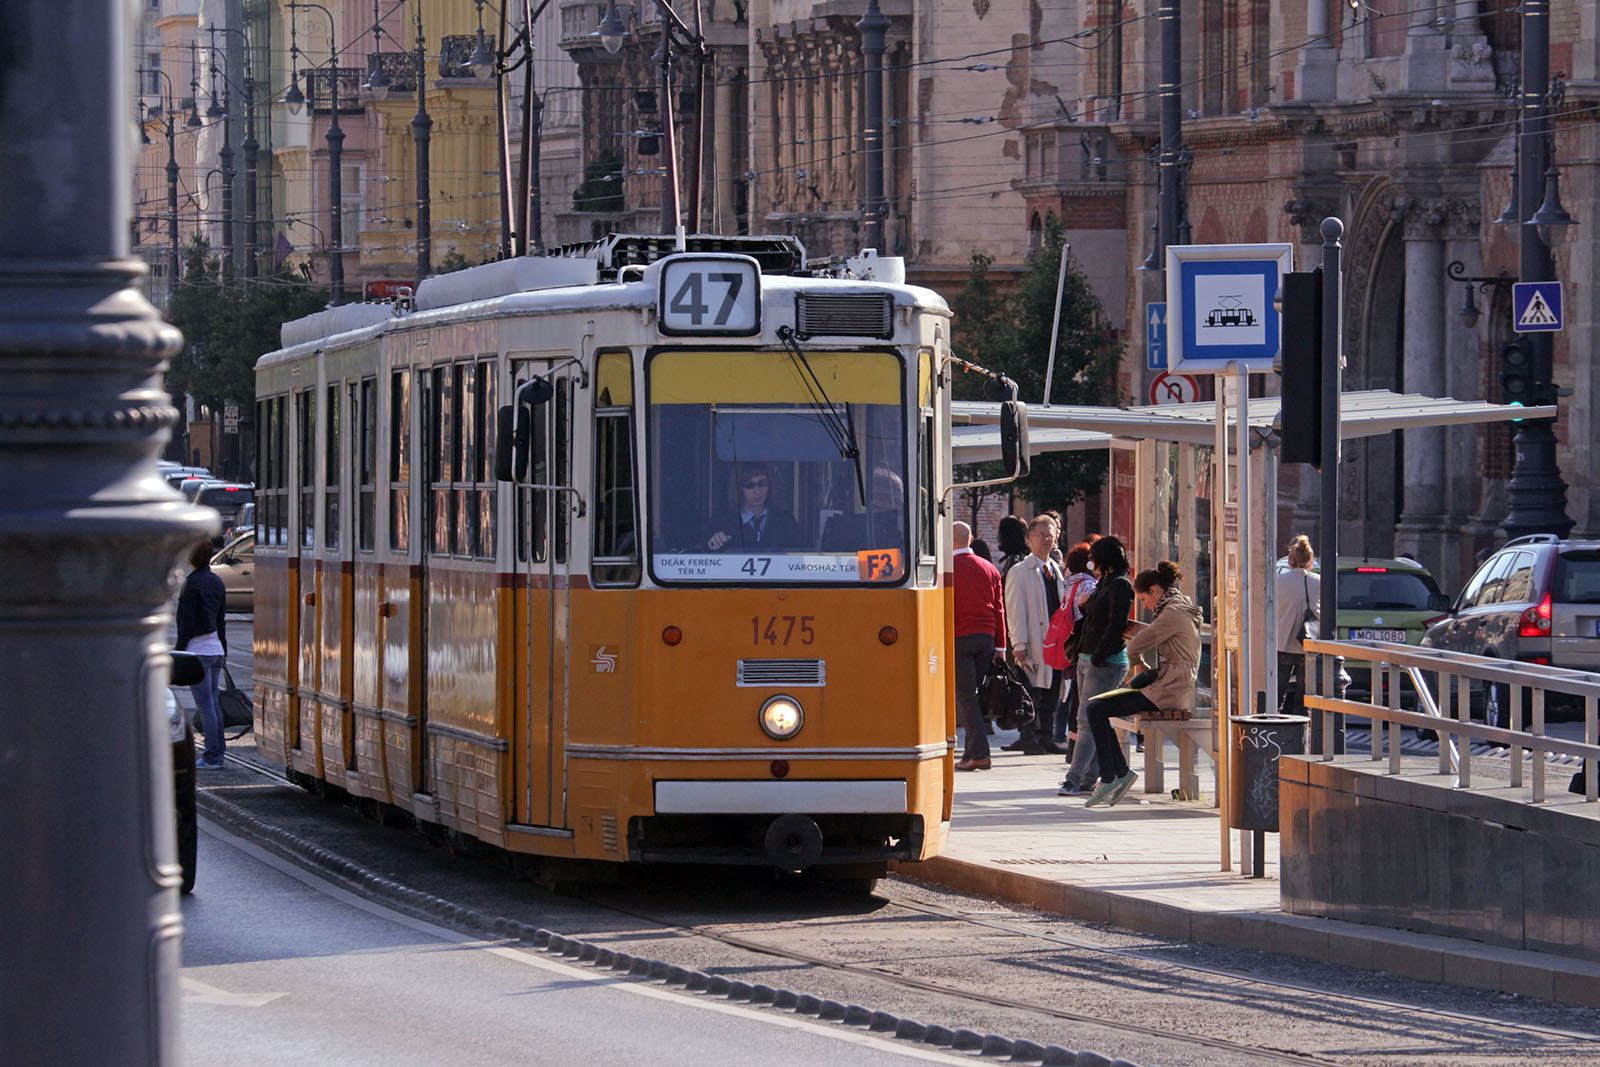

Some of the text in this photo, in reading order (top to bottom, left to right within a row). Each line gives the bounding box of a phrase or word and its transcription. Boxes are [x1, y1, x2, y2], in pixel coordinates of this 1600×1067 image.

[669, 272, 743, 325] 47
[661, 557, 722, 567] DEÁK FERENC
[677, 567, 706, 576] TÉR M
[741, 557, 771, 576] 47
[839, 564, 856, 572] TÉR
[867, 554, 894, 578] F3
[752, 615, 816, 646] 1475
